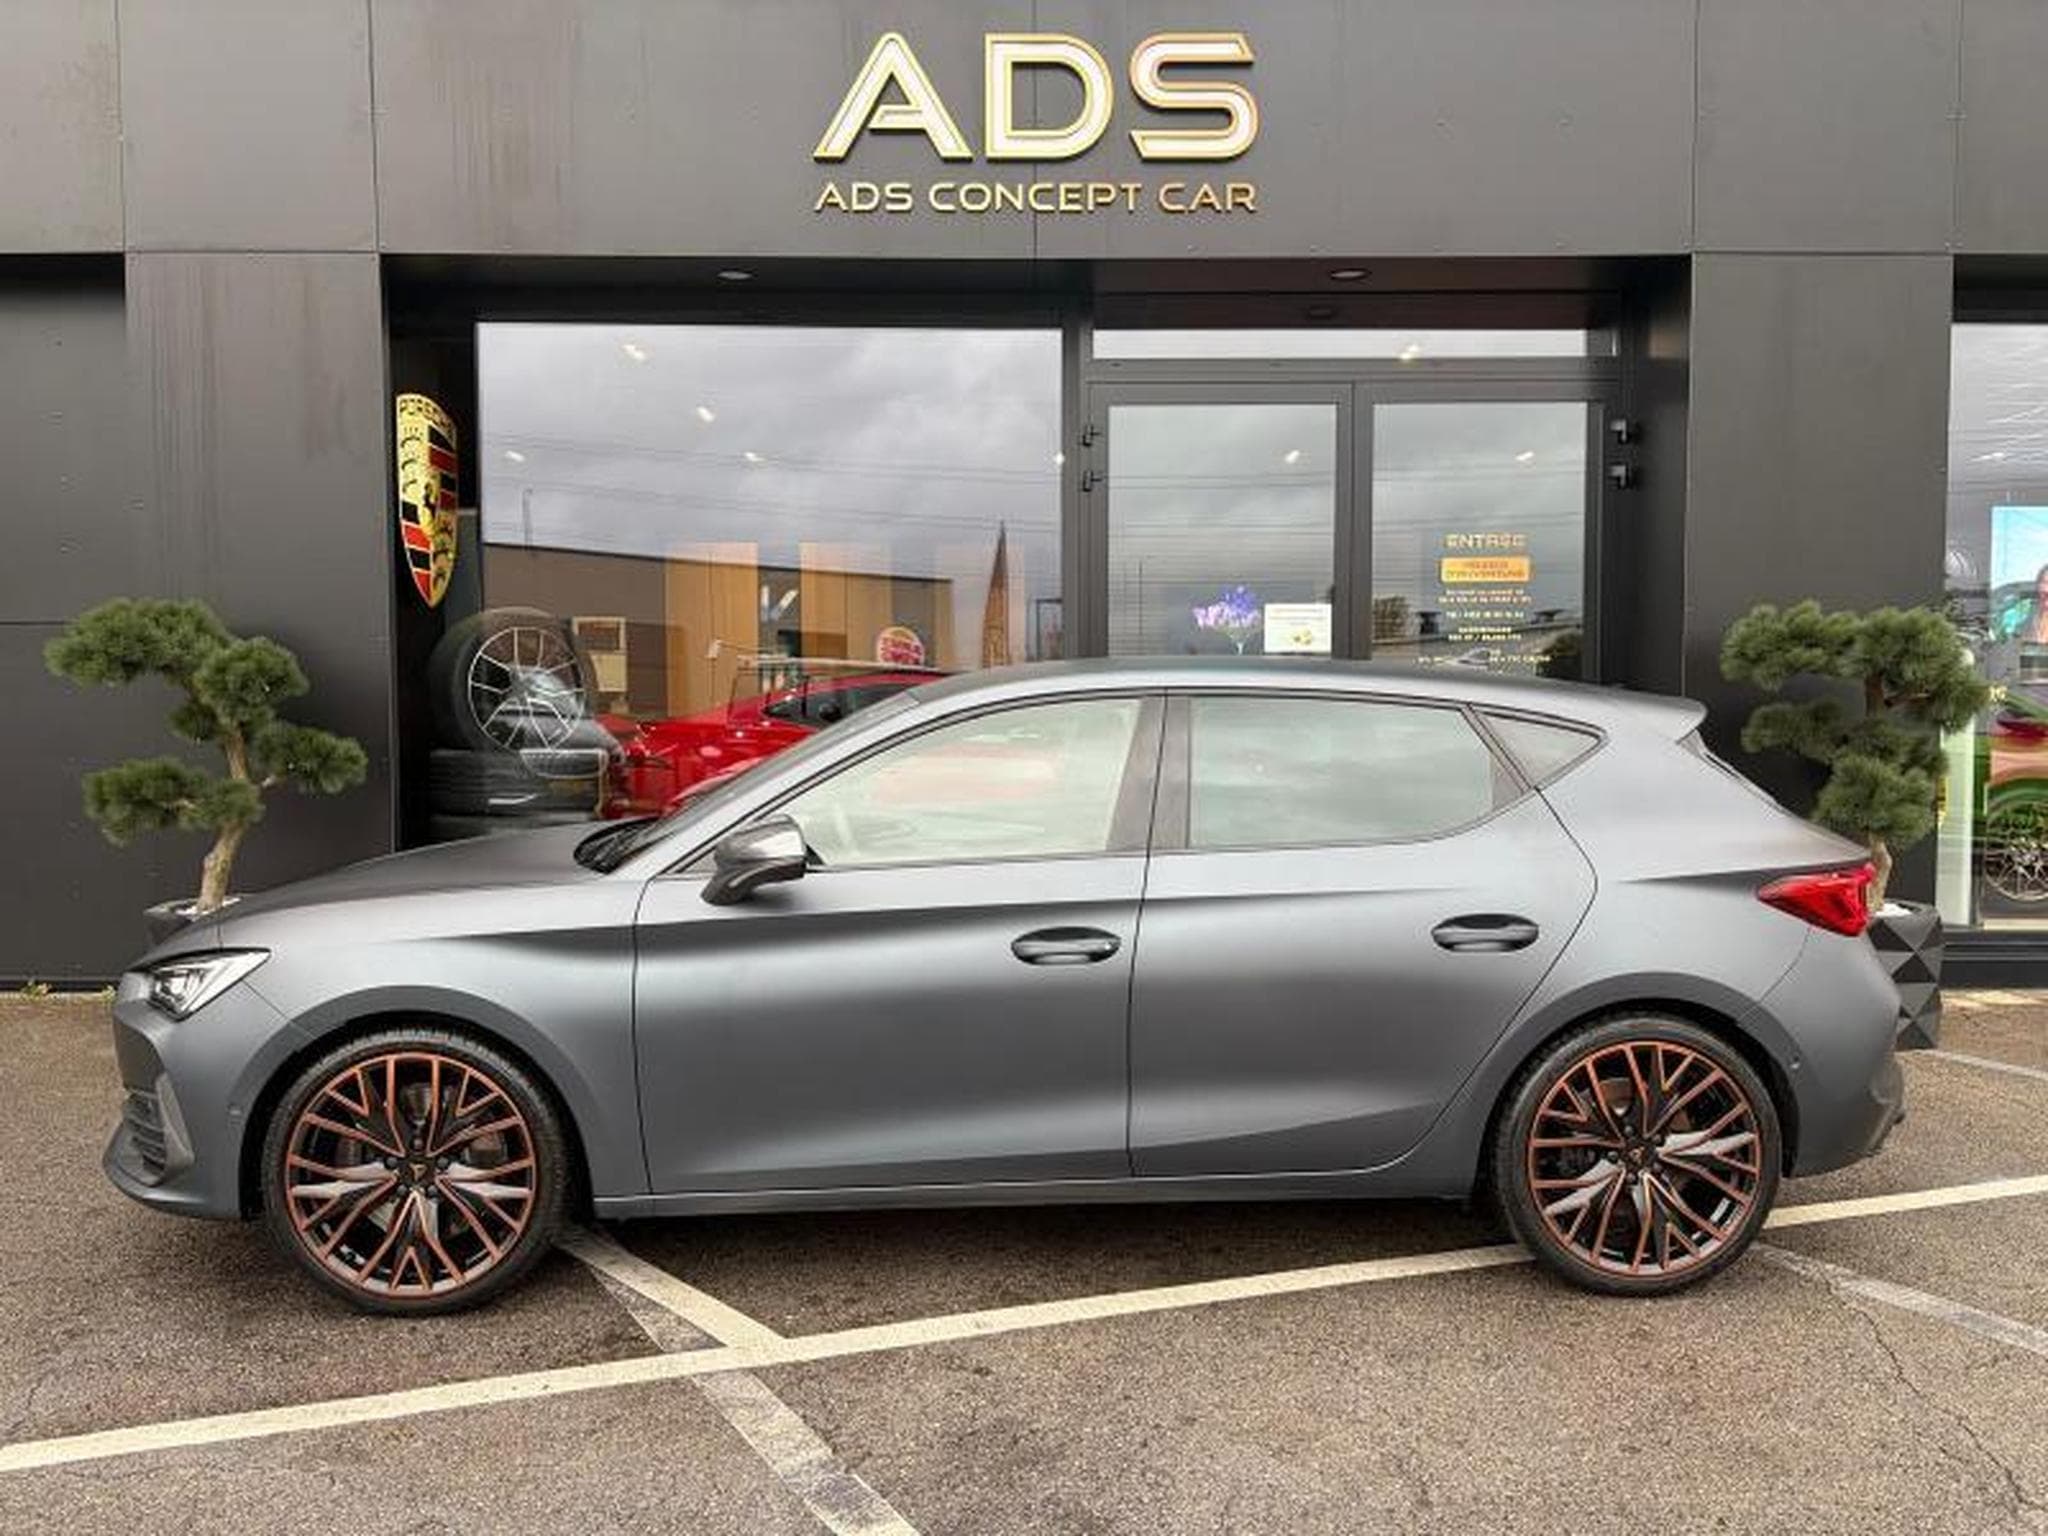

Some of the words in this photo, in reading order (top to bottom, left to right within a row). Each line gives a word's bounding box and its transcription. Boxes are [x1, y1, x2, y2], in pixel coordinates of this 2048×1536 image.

[813, 32, 1259, 161] ADS
[814, 182, 913, 212] ADS
[929, 182, 1142, 212] CONCEPT
[1158, 182, 1257, 212] CAR
